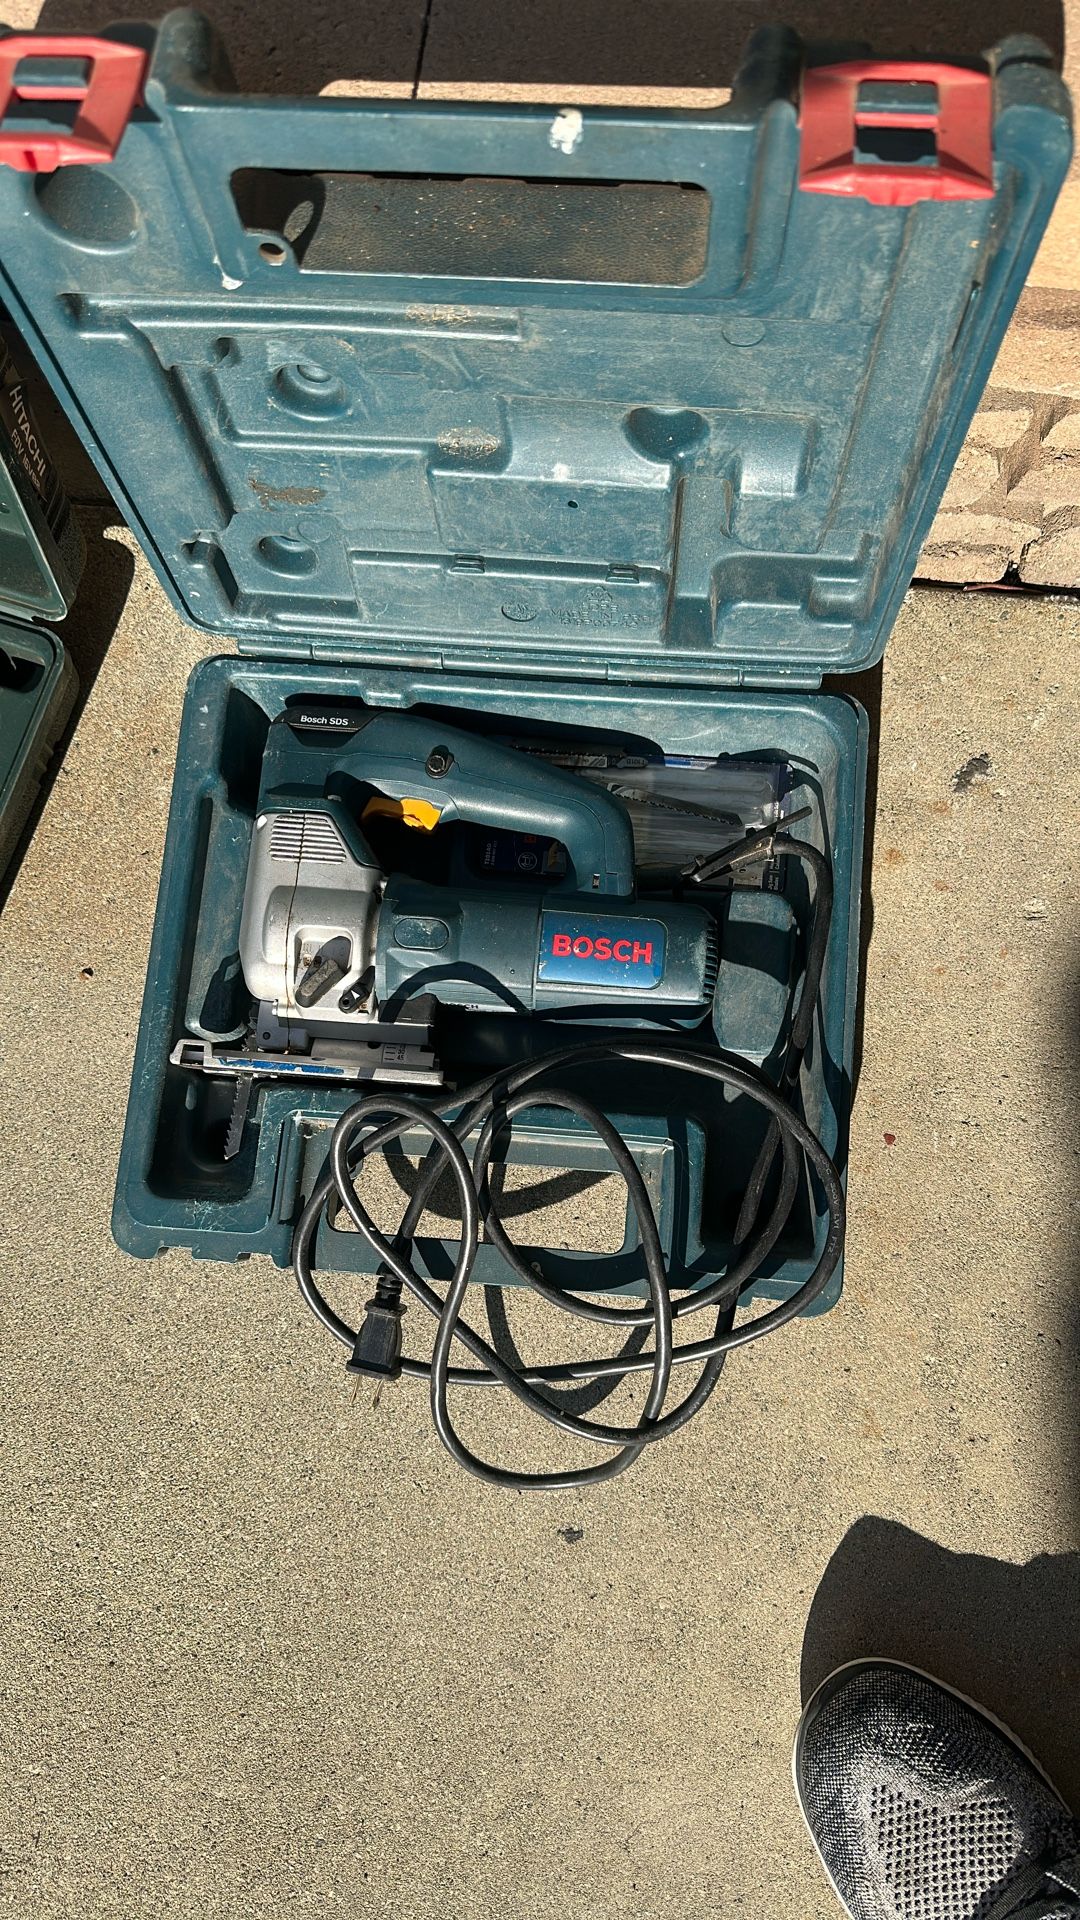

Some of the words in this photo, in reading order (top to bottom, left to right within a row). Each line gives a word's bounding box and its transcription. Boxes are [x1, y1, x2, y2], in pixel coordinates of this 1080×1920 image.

[10, 385, 46, 477] HITACHI
[11, 428, 24, 455] FDV
[551, 608, 589, 619] MADE
[300, 715, 327, 724] Bosch
[329, 717, 349, 726] SDS
[552, 934, 653, 964] BOSCH
